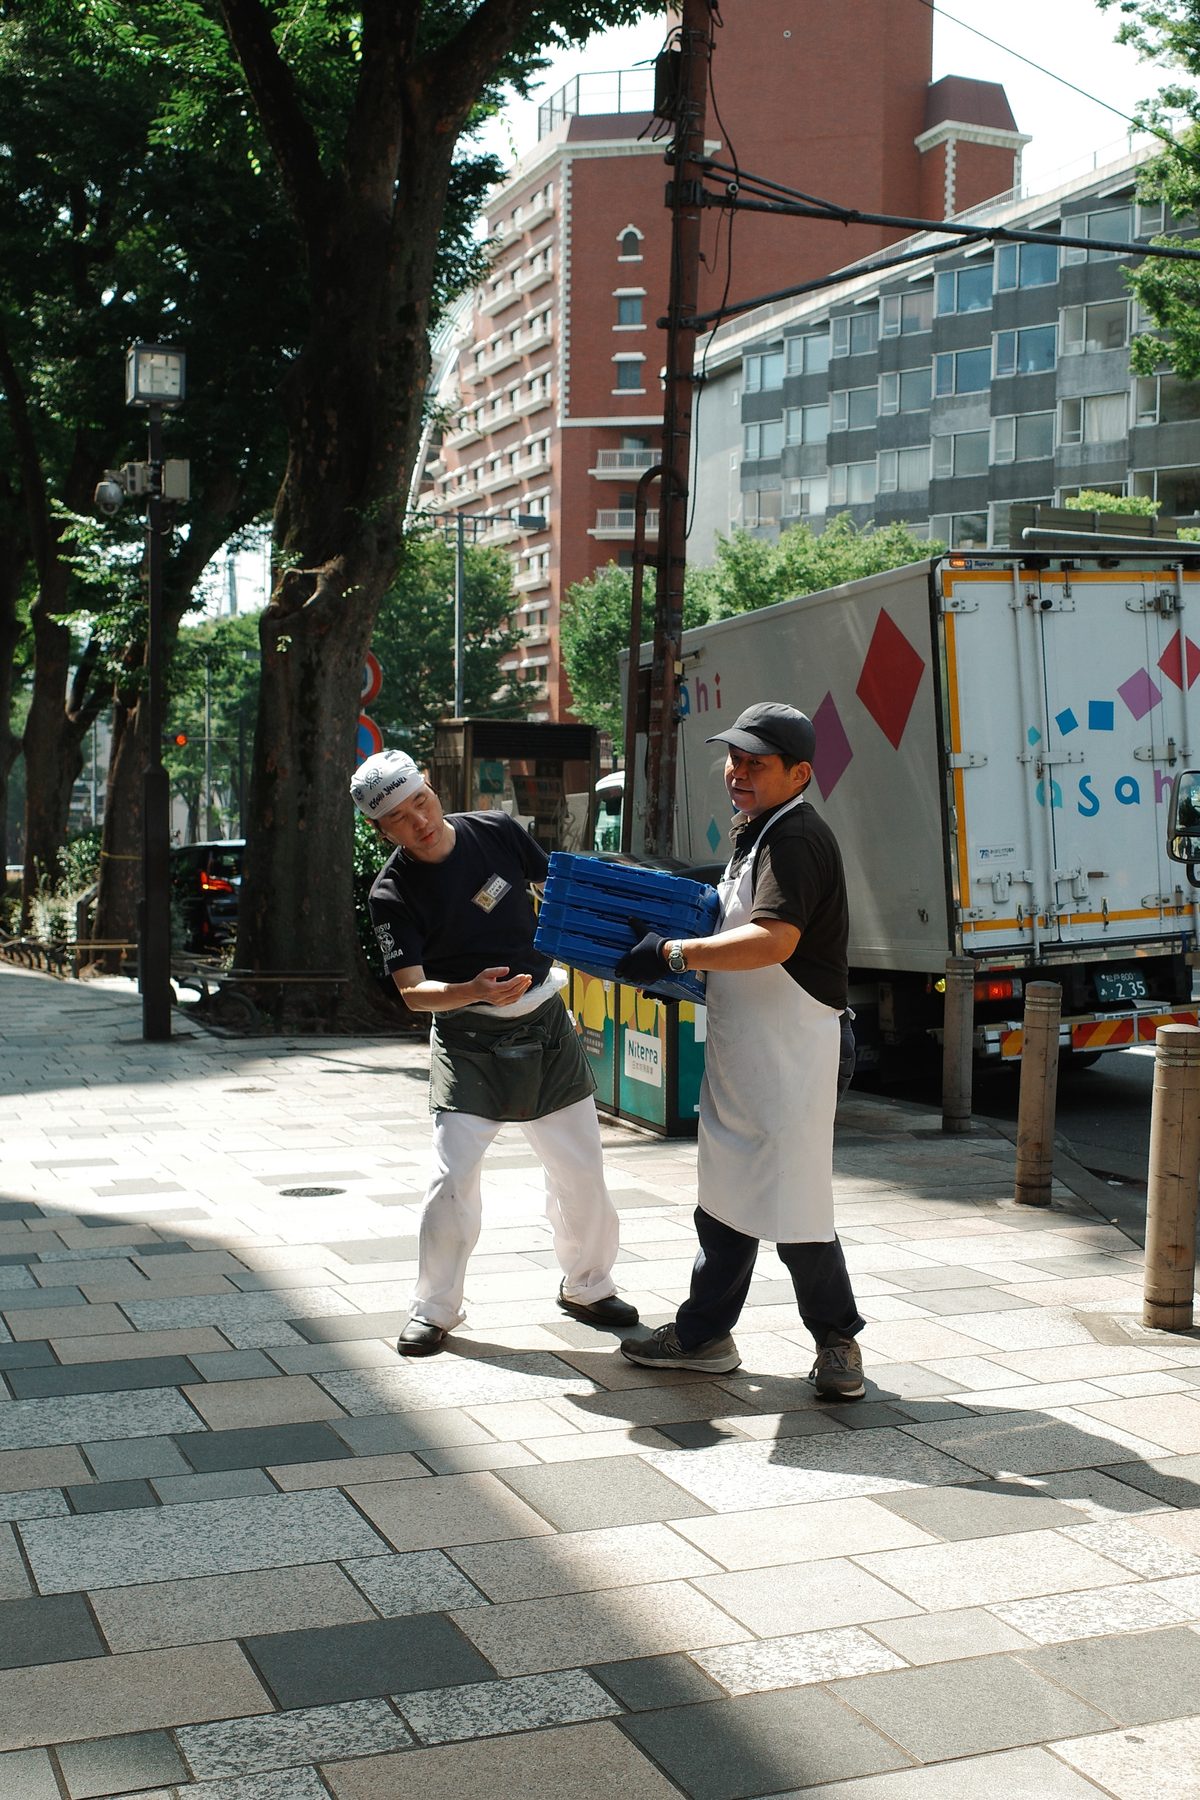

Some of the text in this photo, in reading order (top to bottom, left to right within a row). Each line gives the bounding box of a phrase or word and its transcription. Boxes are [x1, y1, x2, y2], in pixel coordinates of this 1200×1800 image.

[679, 672, 721, 716] ahi
[1035, 769, 1175, 817] asah
[628, 1039, 658, 1065] Niterra
